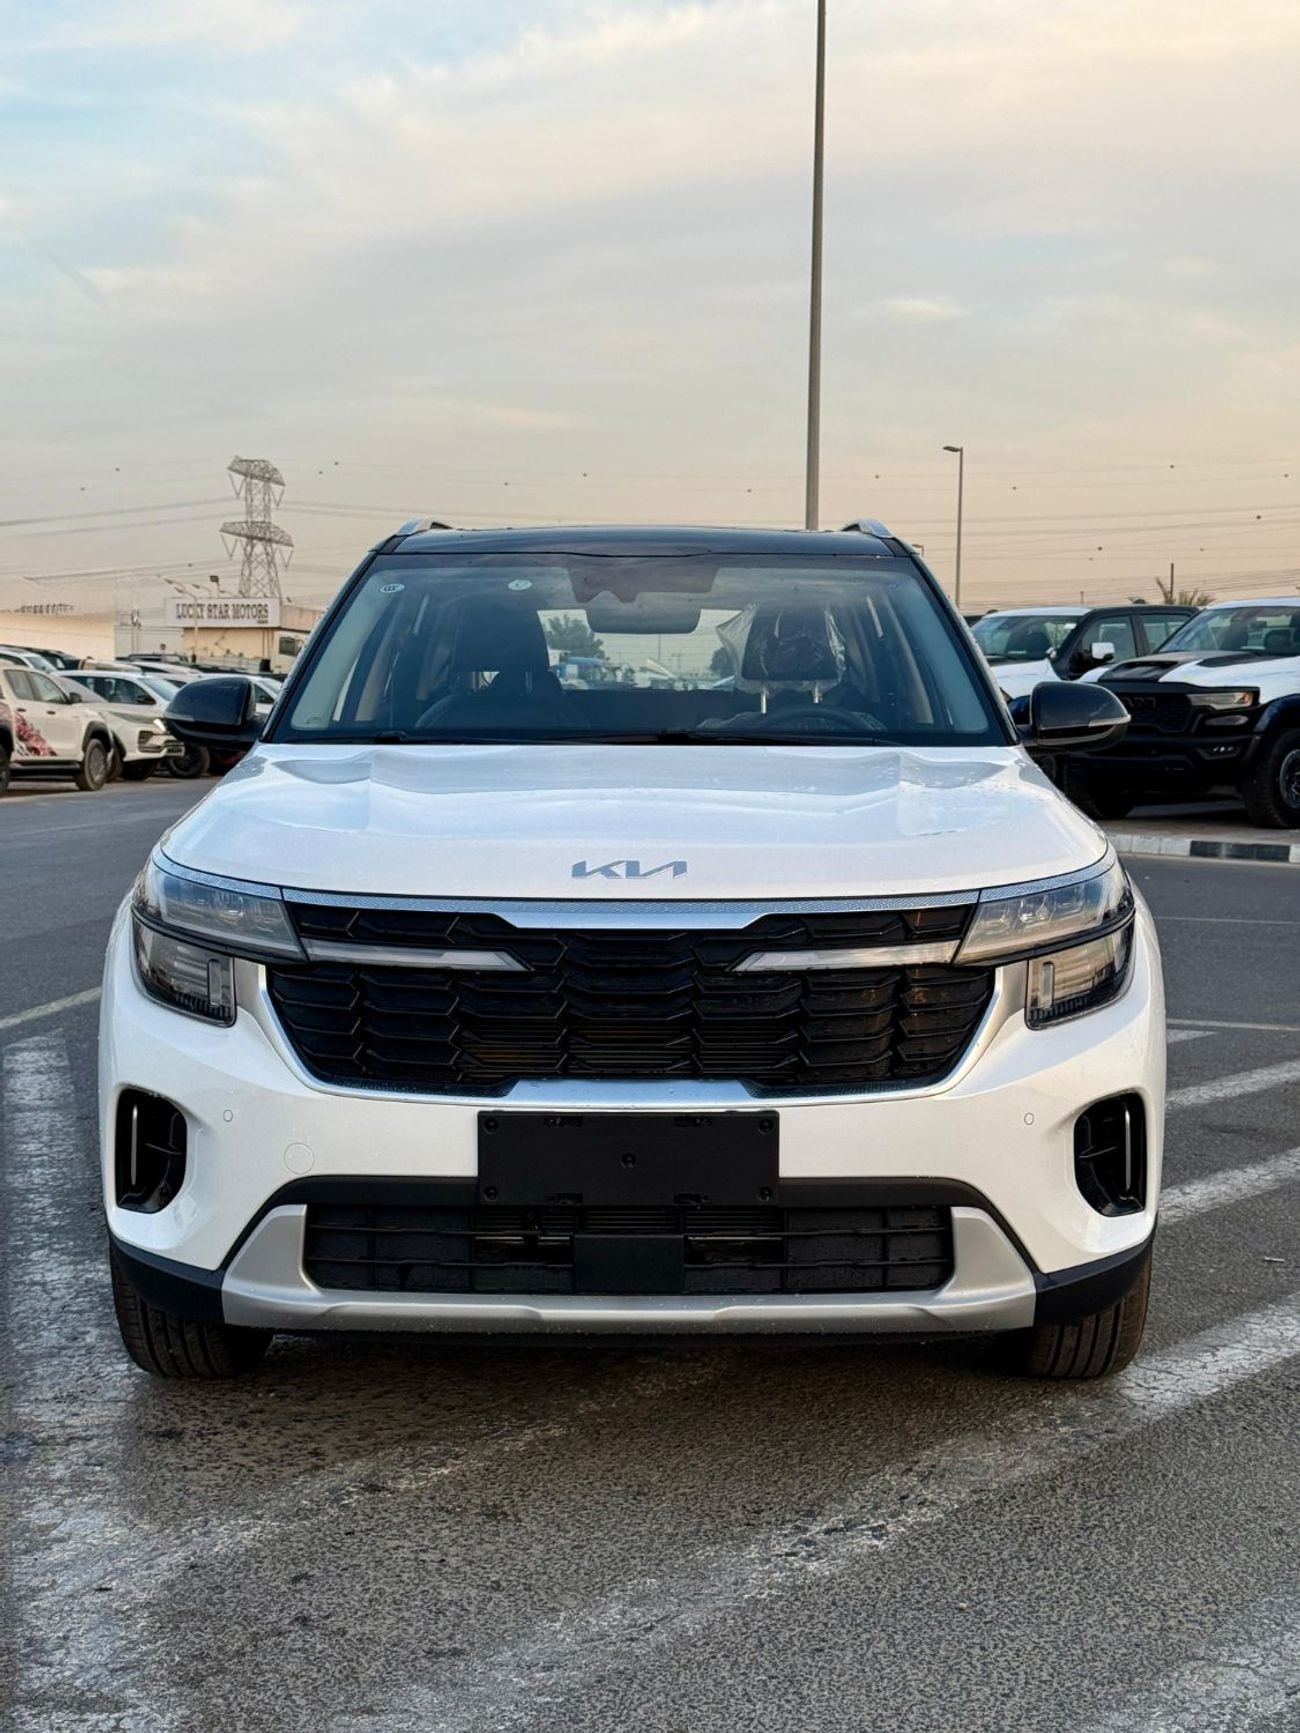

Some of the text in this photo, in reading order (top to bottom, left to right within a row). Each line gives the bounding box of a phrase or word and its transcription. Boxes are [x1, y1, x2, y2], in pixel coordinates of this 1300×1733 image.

[207, 603, 230, 619] STAR
[232, 603, 269, 619] MOTORS
[571, 860, 687, 879] KIA
